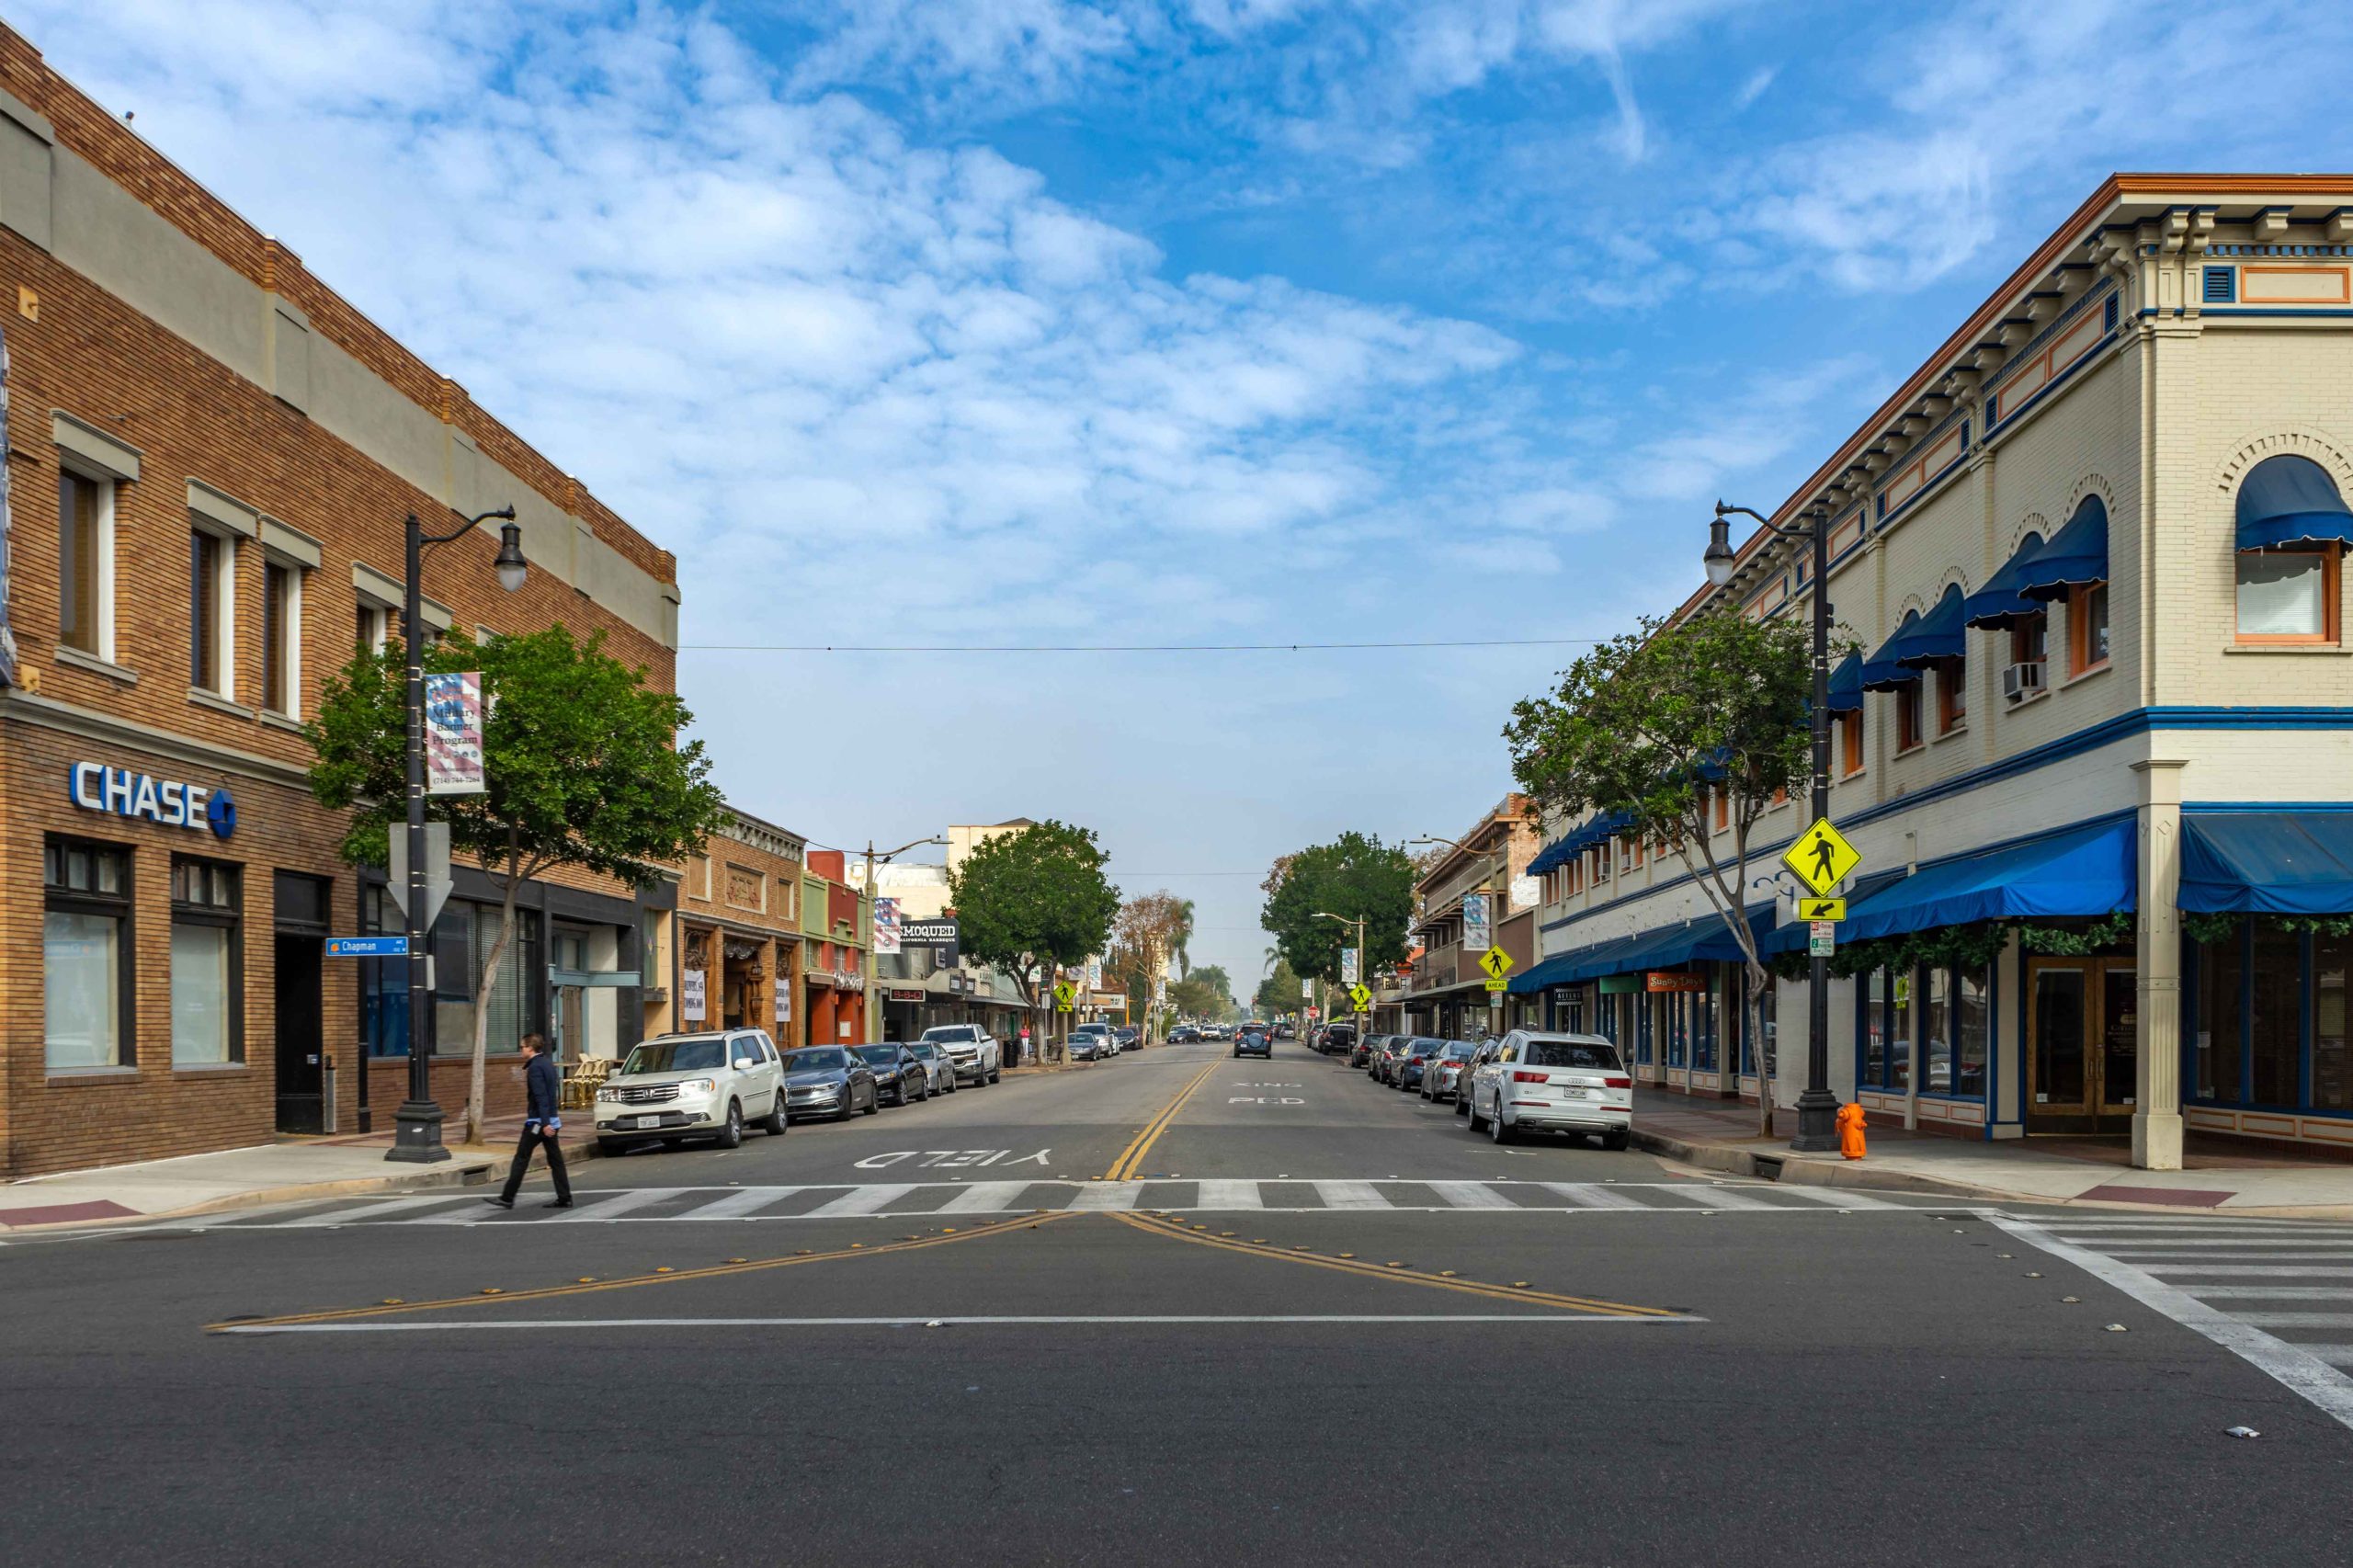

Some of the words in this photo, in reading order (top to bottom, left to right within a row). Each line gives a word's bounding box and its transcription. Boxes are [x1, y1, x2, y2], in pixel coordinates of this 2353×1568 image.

[433, 708, 474, 719] Military
[437, 722, 473, 732] Banner
[432, 735, 478, 747] Program
[70, 761, 209, 830] CHASE
[342, 940, 377, 952] Chapman
[1650, 976, 1678, 988] Sunny
[853, 1149, 1051, 1168] YIELD
